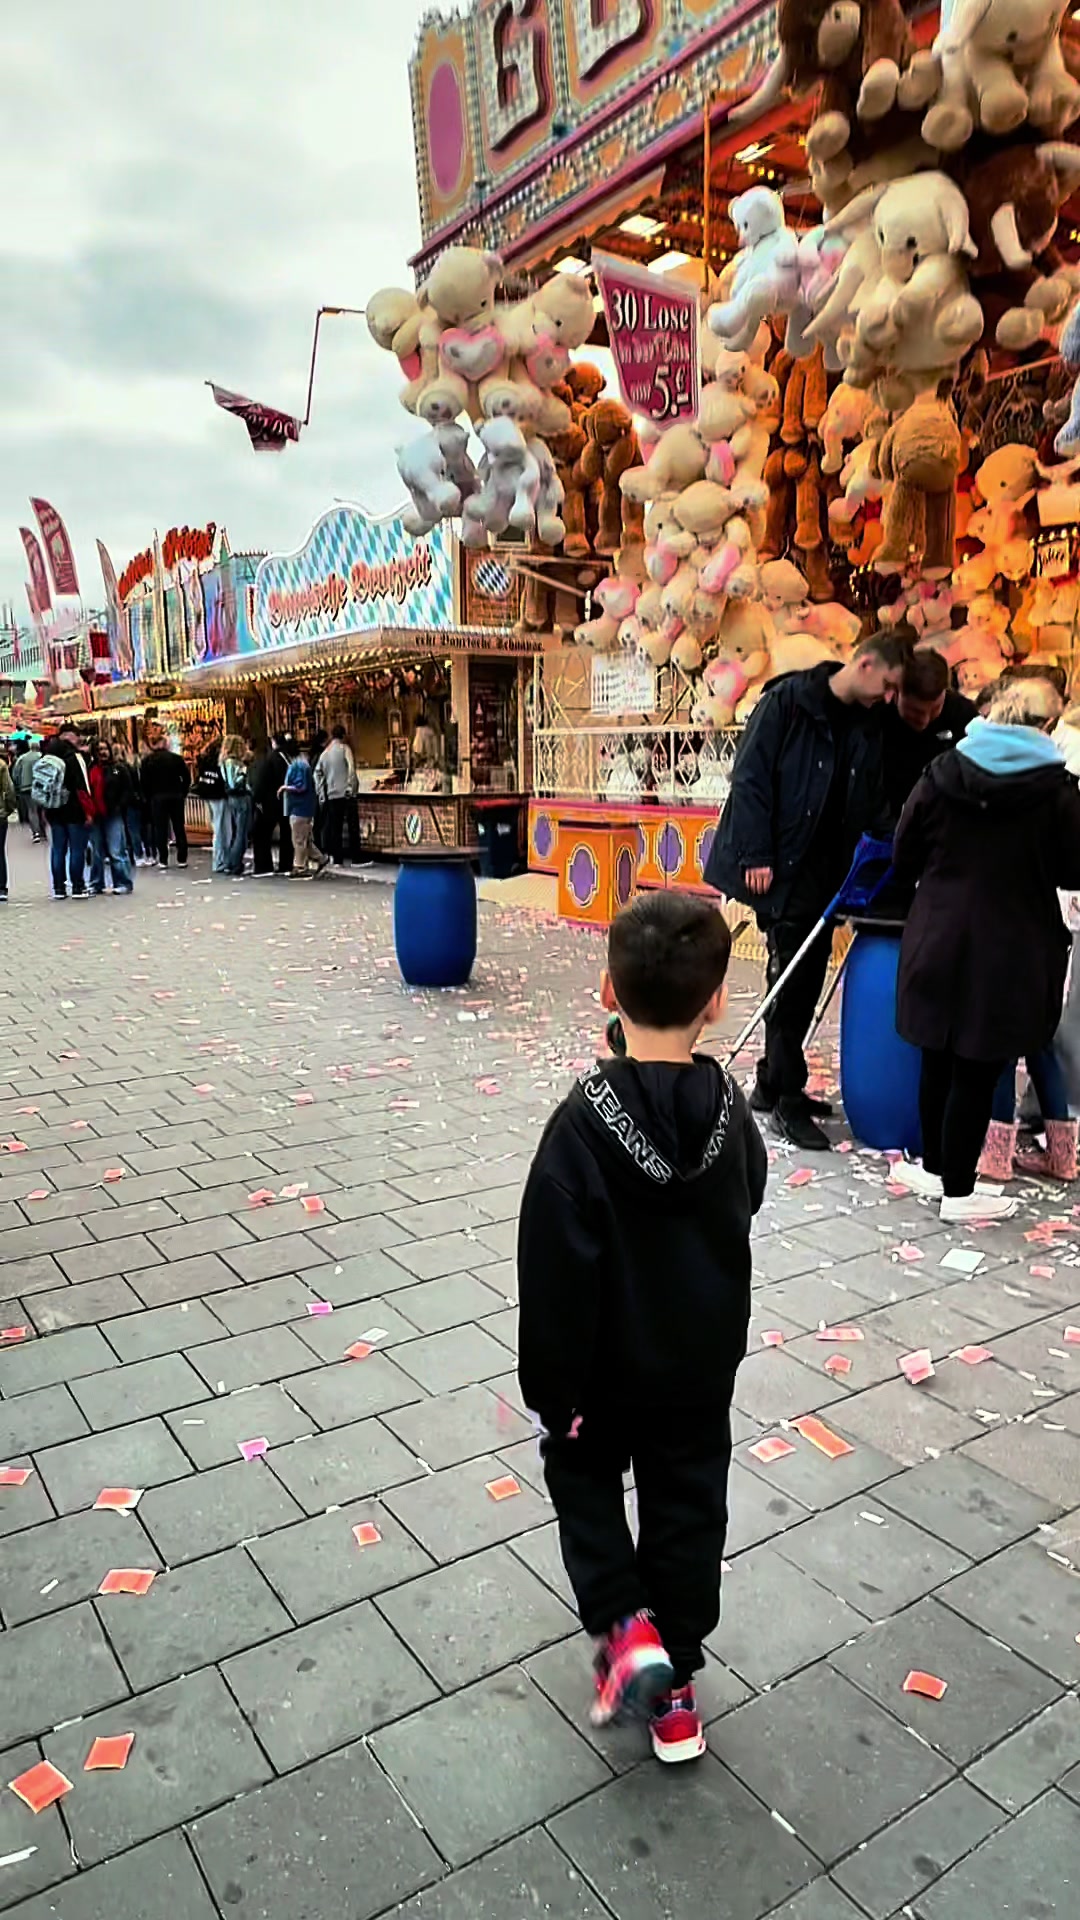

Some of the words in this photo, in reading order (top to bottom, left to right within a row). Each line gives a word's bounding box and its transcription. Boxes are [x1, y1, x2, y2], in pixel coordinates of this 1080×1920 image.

[611, 287, 638, 332] 30
[643, 294, 690, 333] Lose
[584, 1078, 673, 1185] JEANS
